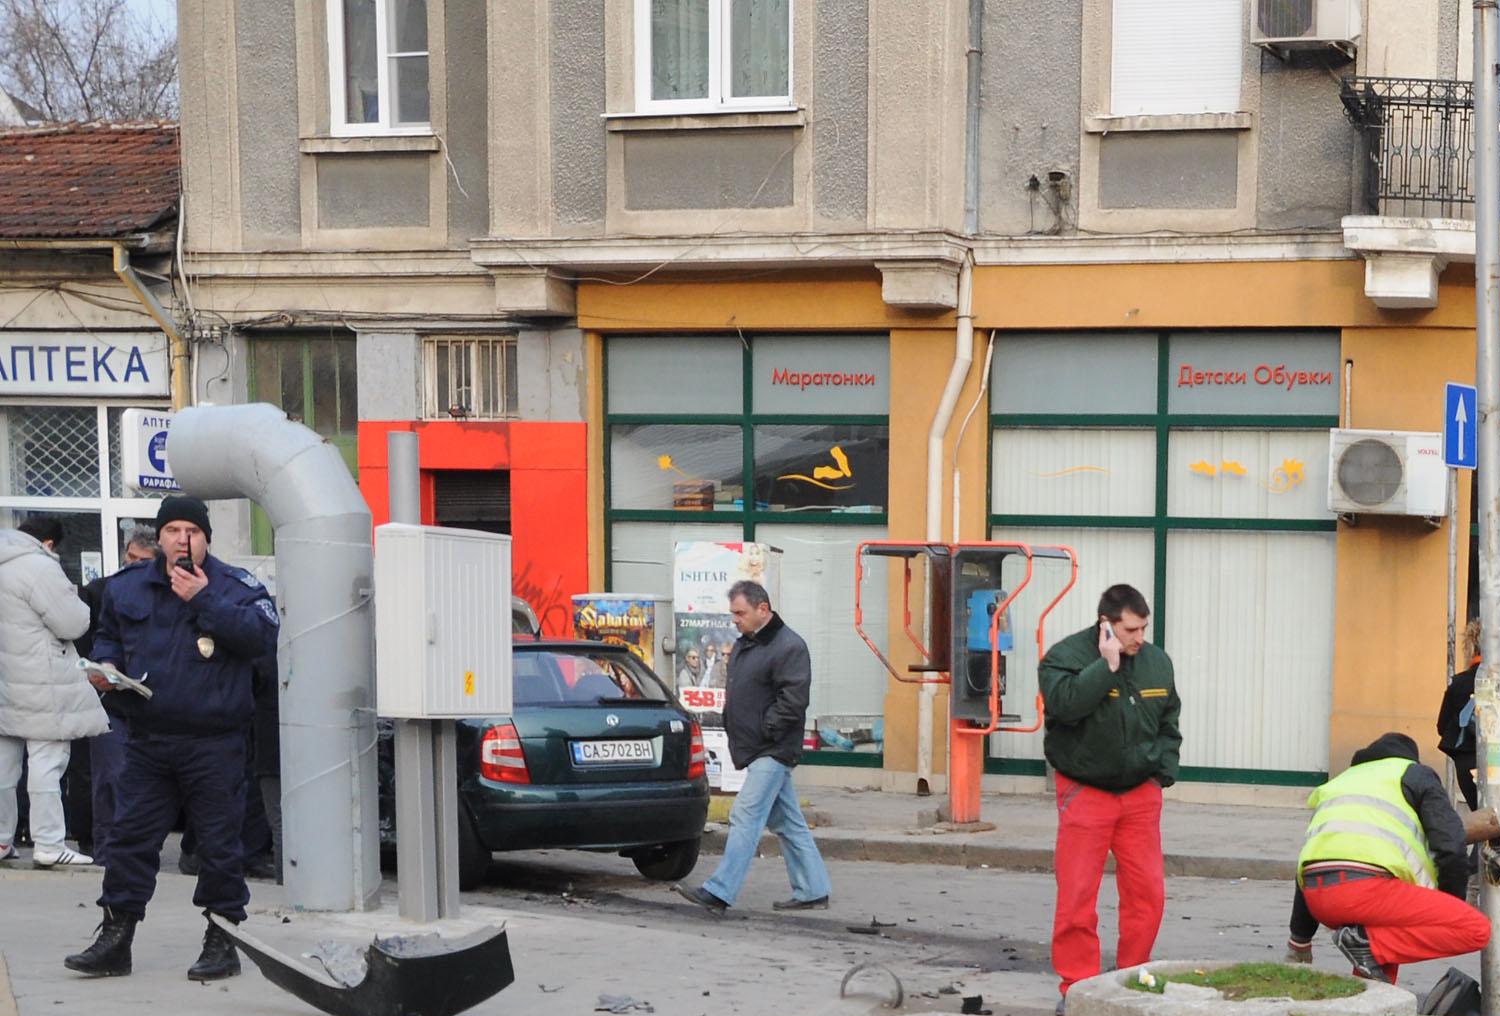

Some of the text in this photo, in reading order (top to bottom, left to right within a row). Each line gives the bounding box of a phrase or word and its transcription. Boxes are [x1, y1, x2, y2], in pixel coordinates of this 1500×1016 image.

[772, 368, 876, 391] Маратонки
[1178, 364, 1333, 391] Детски Обувки
[143, 416, 171, 428] АПТЕ
[680, 571, 727, 582] ISHTAR
